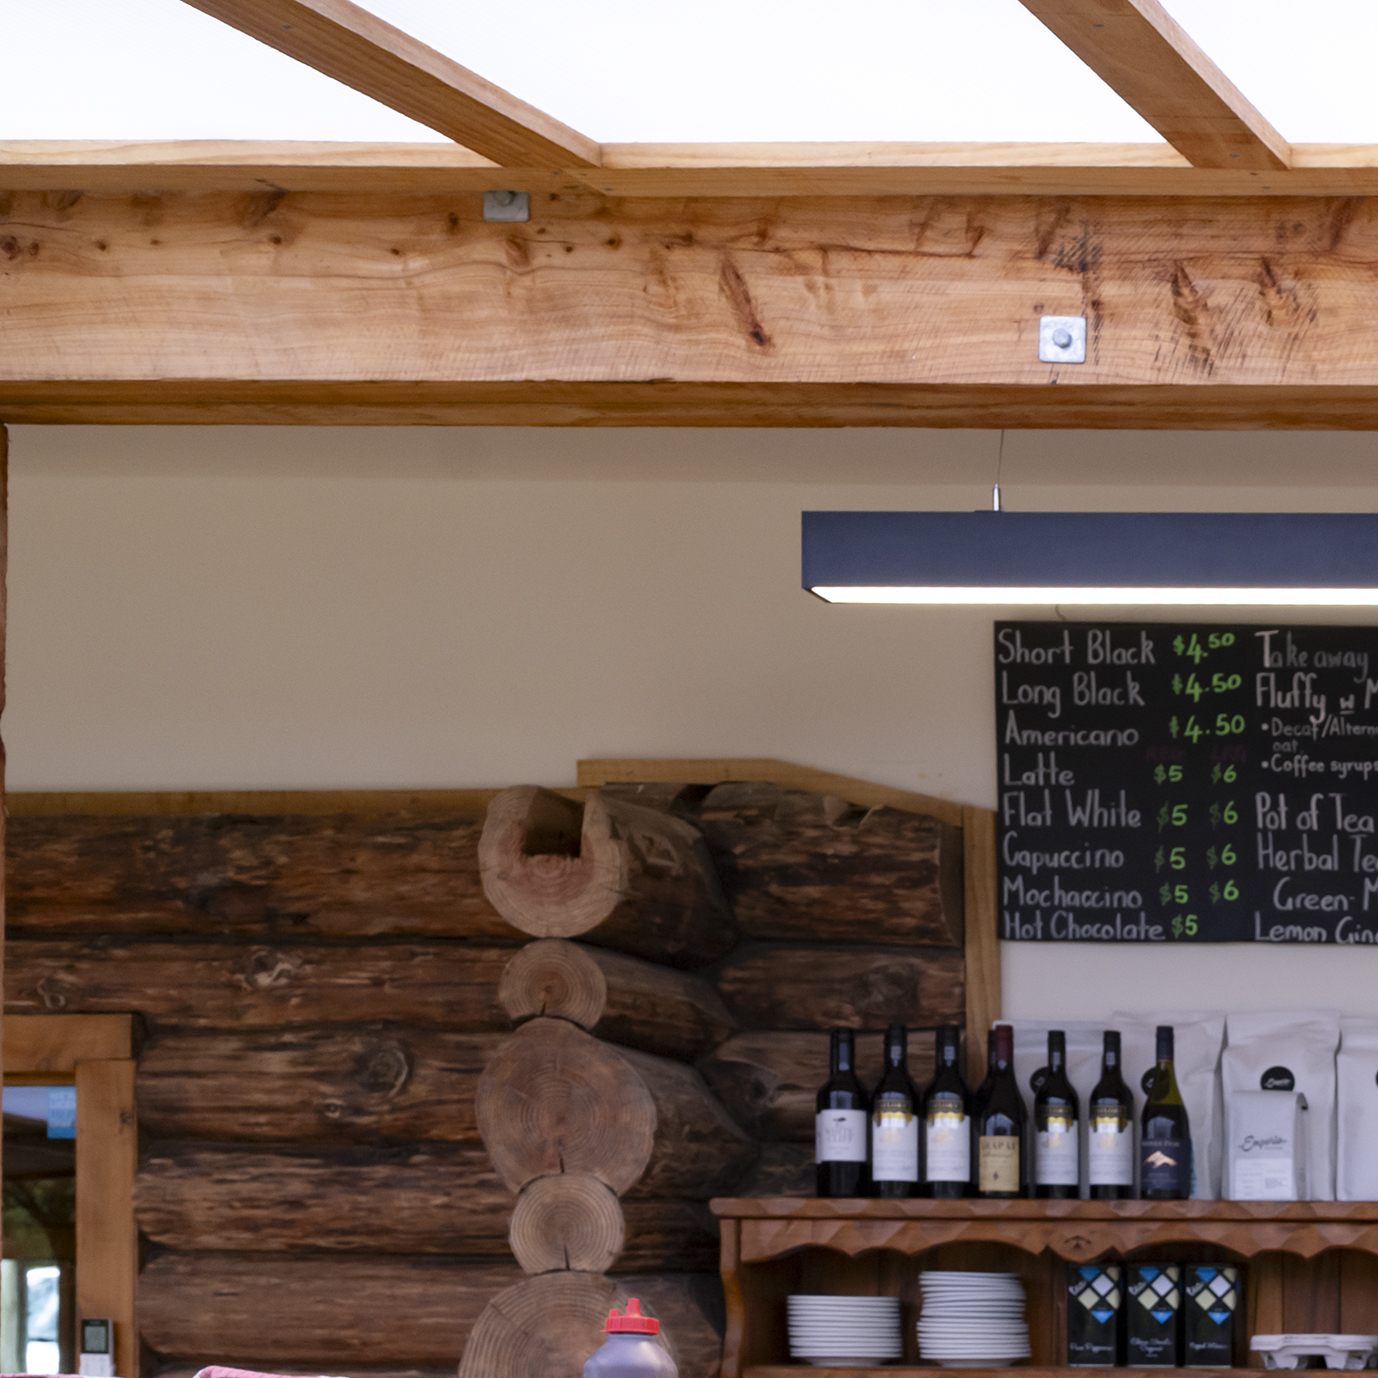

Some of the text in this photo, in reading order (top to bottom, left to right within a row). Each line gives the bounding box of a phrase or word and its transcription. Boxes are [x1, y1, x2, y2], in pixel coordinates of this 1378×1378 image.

[998, 628, 1235, 665] Short Black $4.50
[1001, 670, 1242, 718] Long Black $4.50
[1004, 709, 1245, 746] Americano $4.50
[1003, 751, 1237, 786] Latte $5 $6
[1003, 788, 1238, 833] Flat White $5 $6
[1003, 830, 1237, 875] Capuccino $5 $6
[1004, 910, 1198, 941] Hot Chocolate $5
